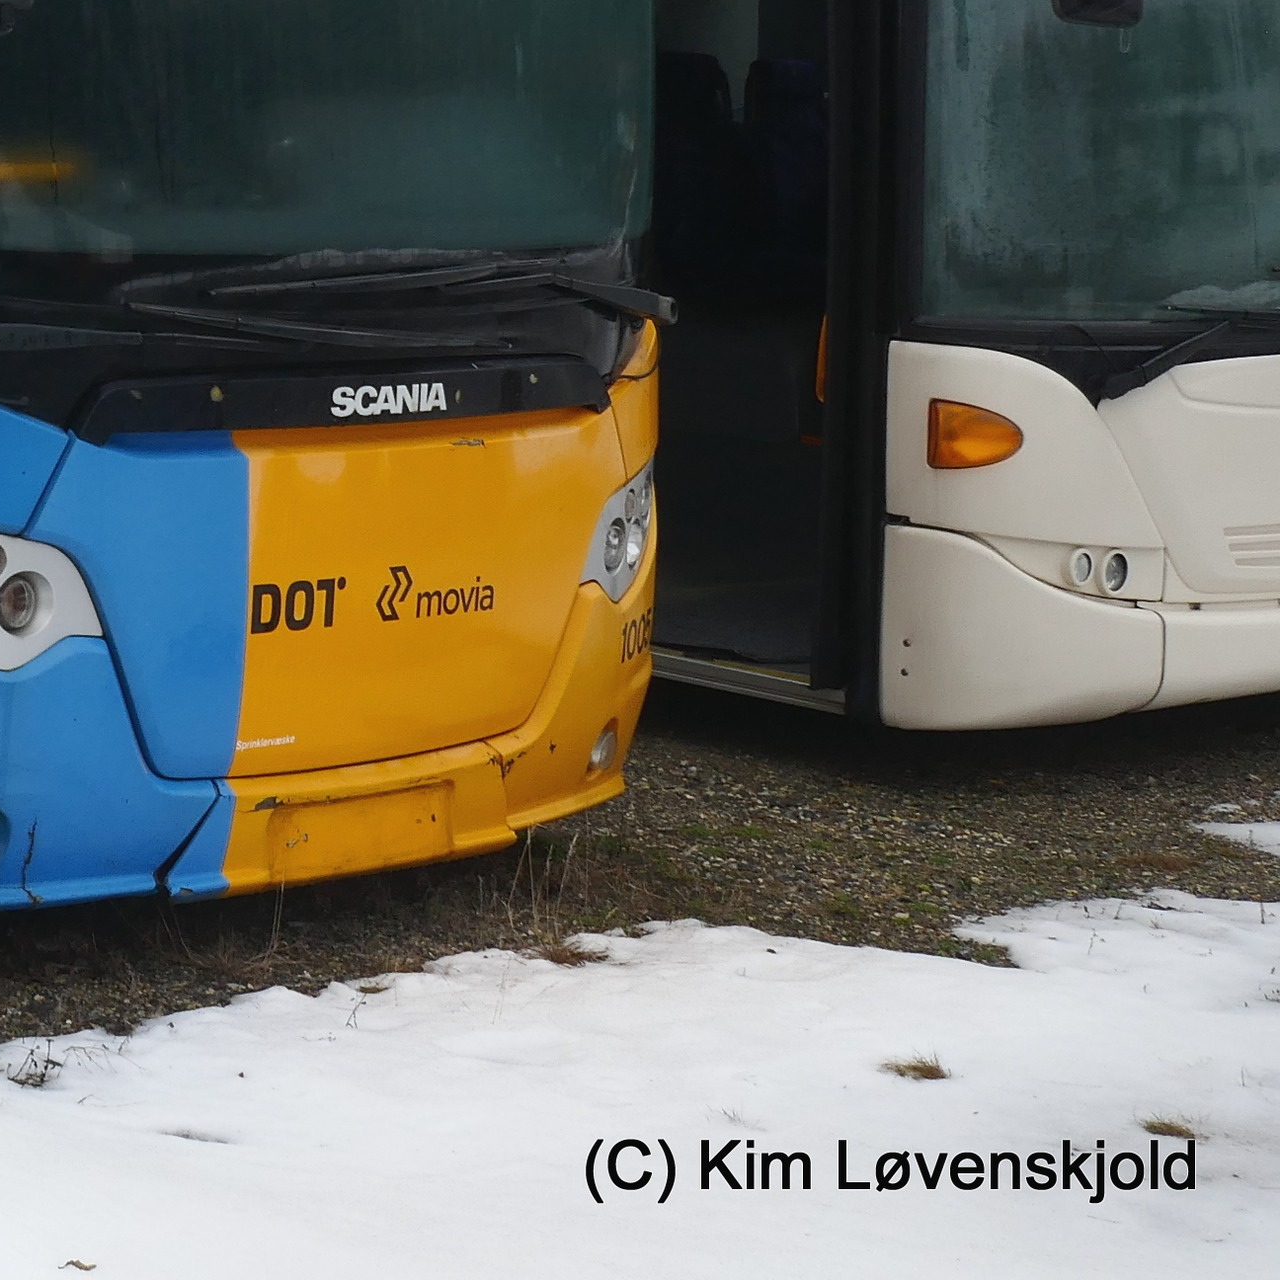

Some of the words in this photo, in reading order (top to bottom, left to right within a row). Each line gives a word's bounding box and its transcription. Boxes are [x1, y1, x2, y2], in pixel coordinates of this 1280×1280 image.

[330, 382, 448, 418] SCANIA
[250, 576, 347, 635] DOT
[415, 576, 495, 619] movia
